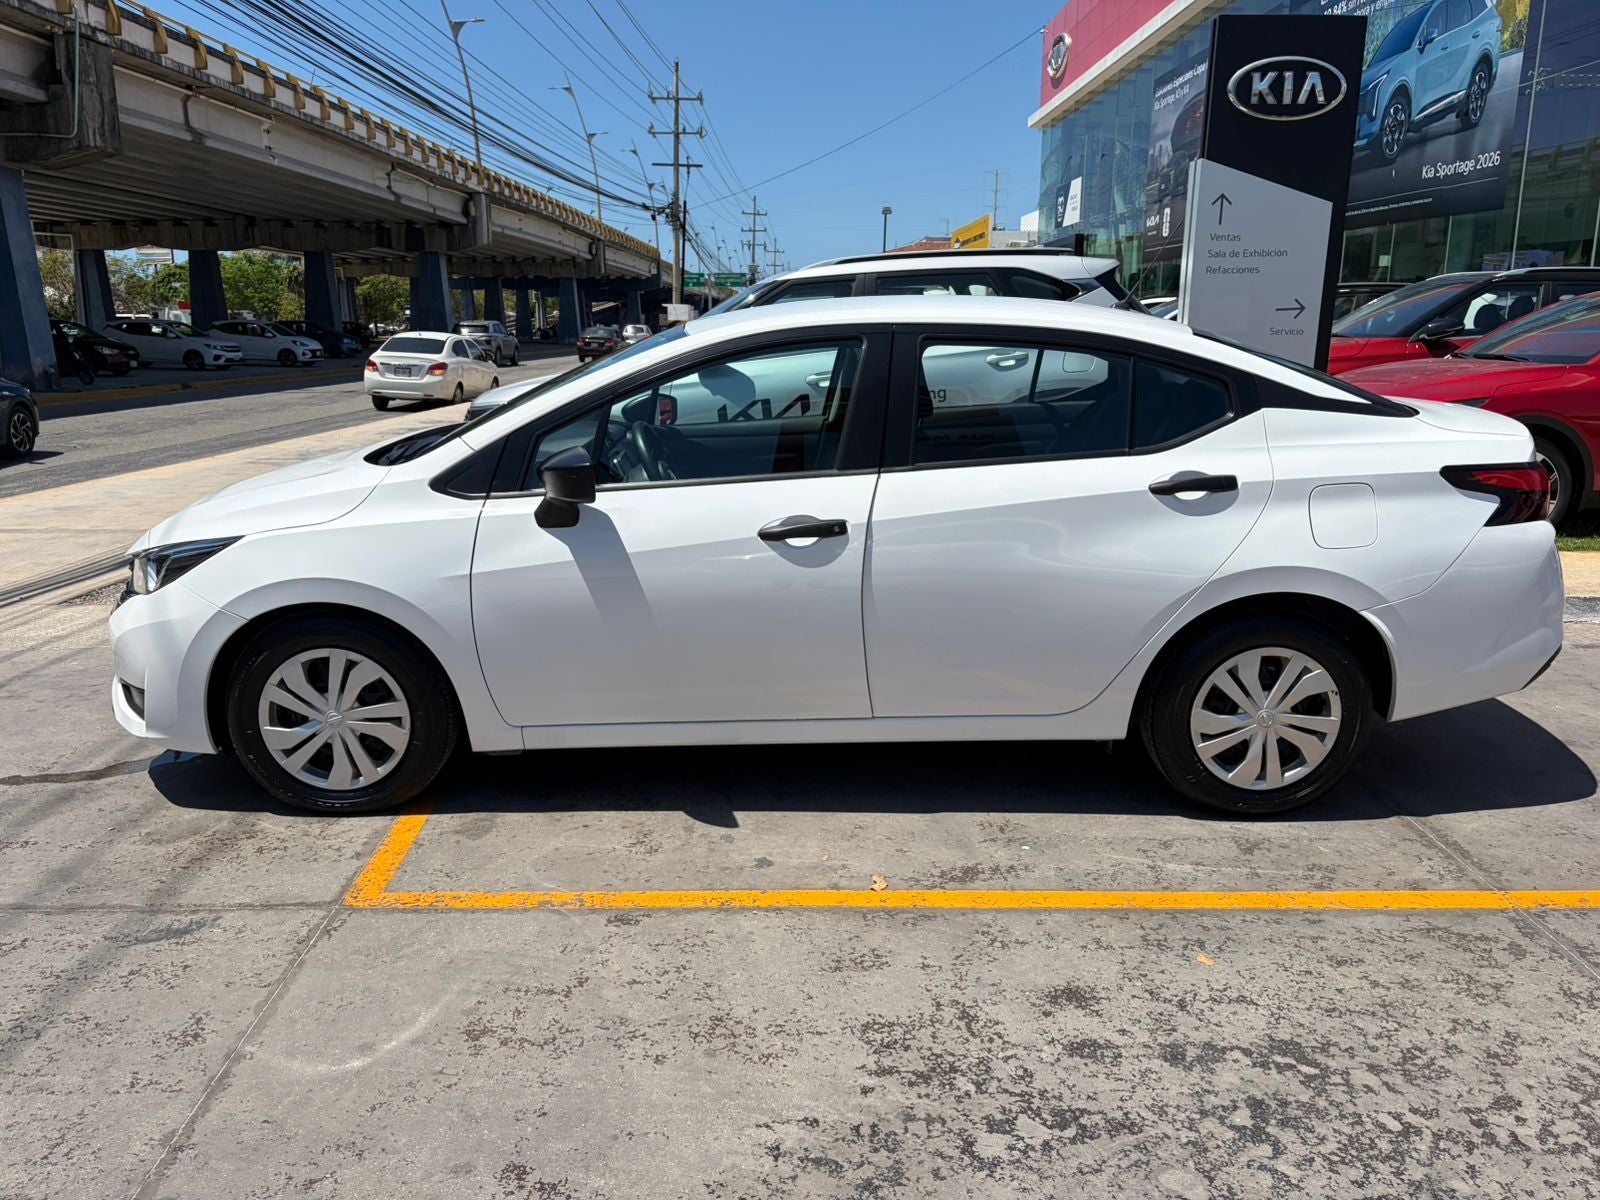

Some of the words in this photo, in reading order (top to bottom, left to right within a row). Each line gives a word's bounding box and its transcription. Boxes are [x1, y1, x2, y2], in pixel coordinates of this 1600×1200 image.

[1250, 71, 1326, 105] KIA
[1421, 164, 1435, 179] Kia
[1436, 159, 1475, 179] Sportage
[1476, 150, 1501, 169] 2026
[1209, 232, 1241, 242] Ventas
[1207, 249, 1226, 258] Sala
[1228, 249, 1240, 258] de
[1242, 248, 1288, 258] Exhibición
[1205, 265, 1260, 275] Refacciones
[1269, 326, 1304, 336] Servicio
